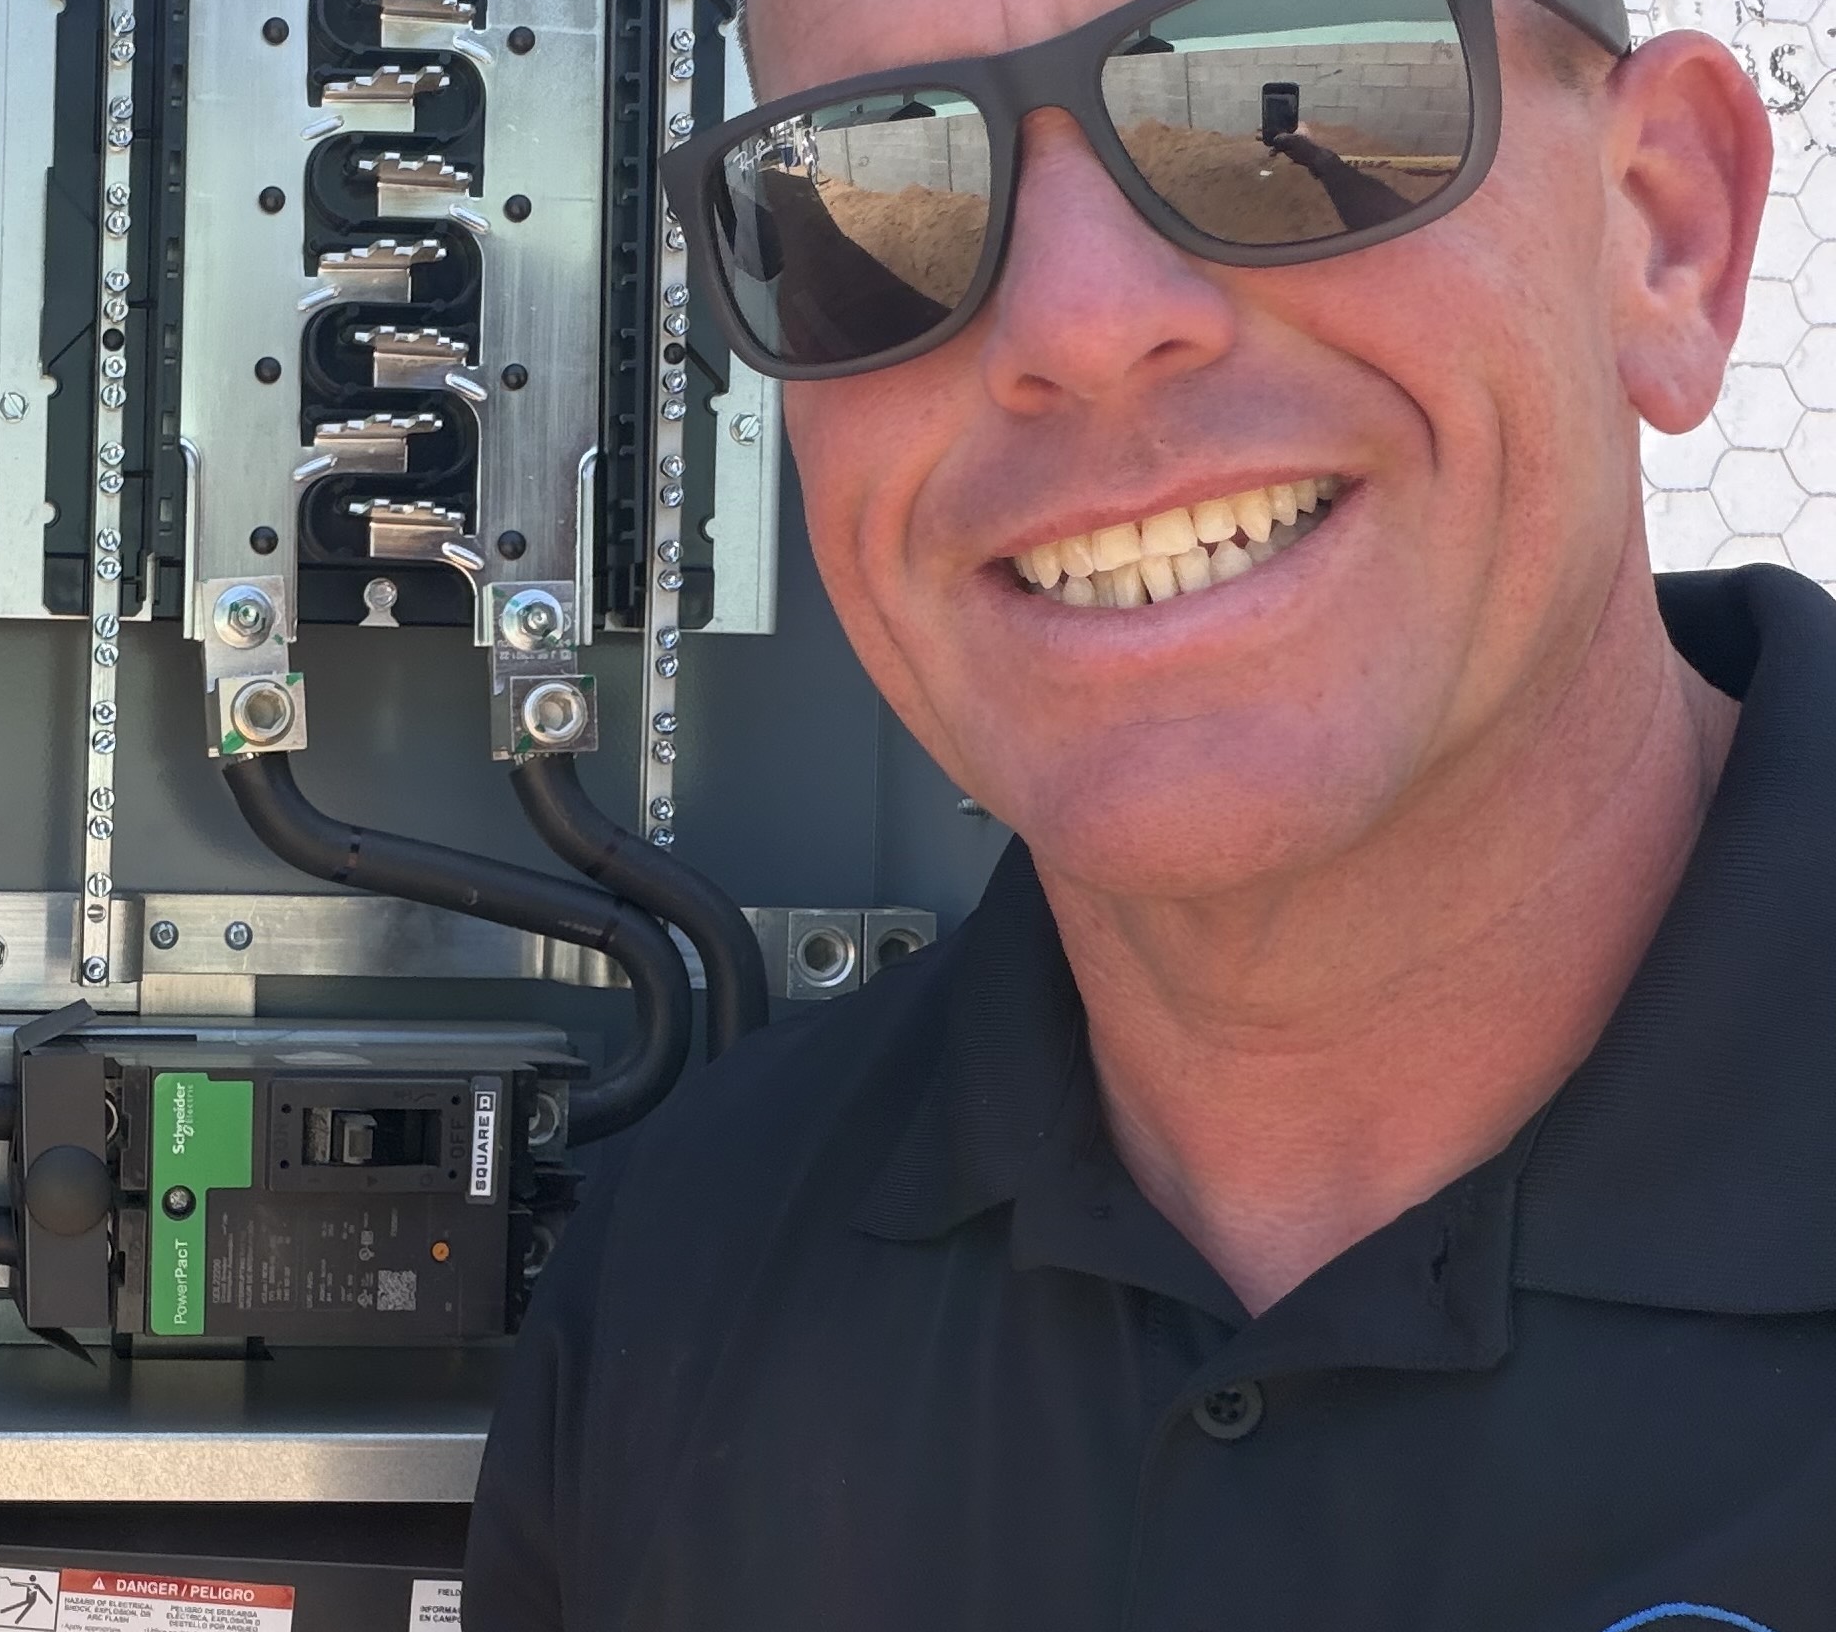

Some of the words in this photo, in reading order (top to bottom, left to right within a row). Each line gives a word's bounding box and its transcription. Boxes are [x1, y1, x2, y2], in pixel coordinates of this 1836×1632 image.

[172, 1081, 186, 1155] Schneider
[475, 1114, 491, 1192] SQUARE
[174, 1237, 189, 1326] PowerPacT
[104, 1614, 129, 1623] FLASH
[116, 1578, 178, 1597] DANGER
[191, 1585, 256, 1602] PELIGRO
